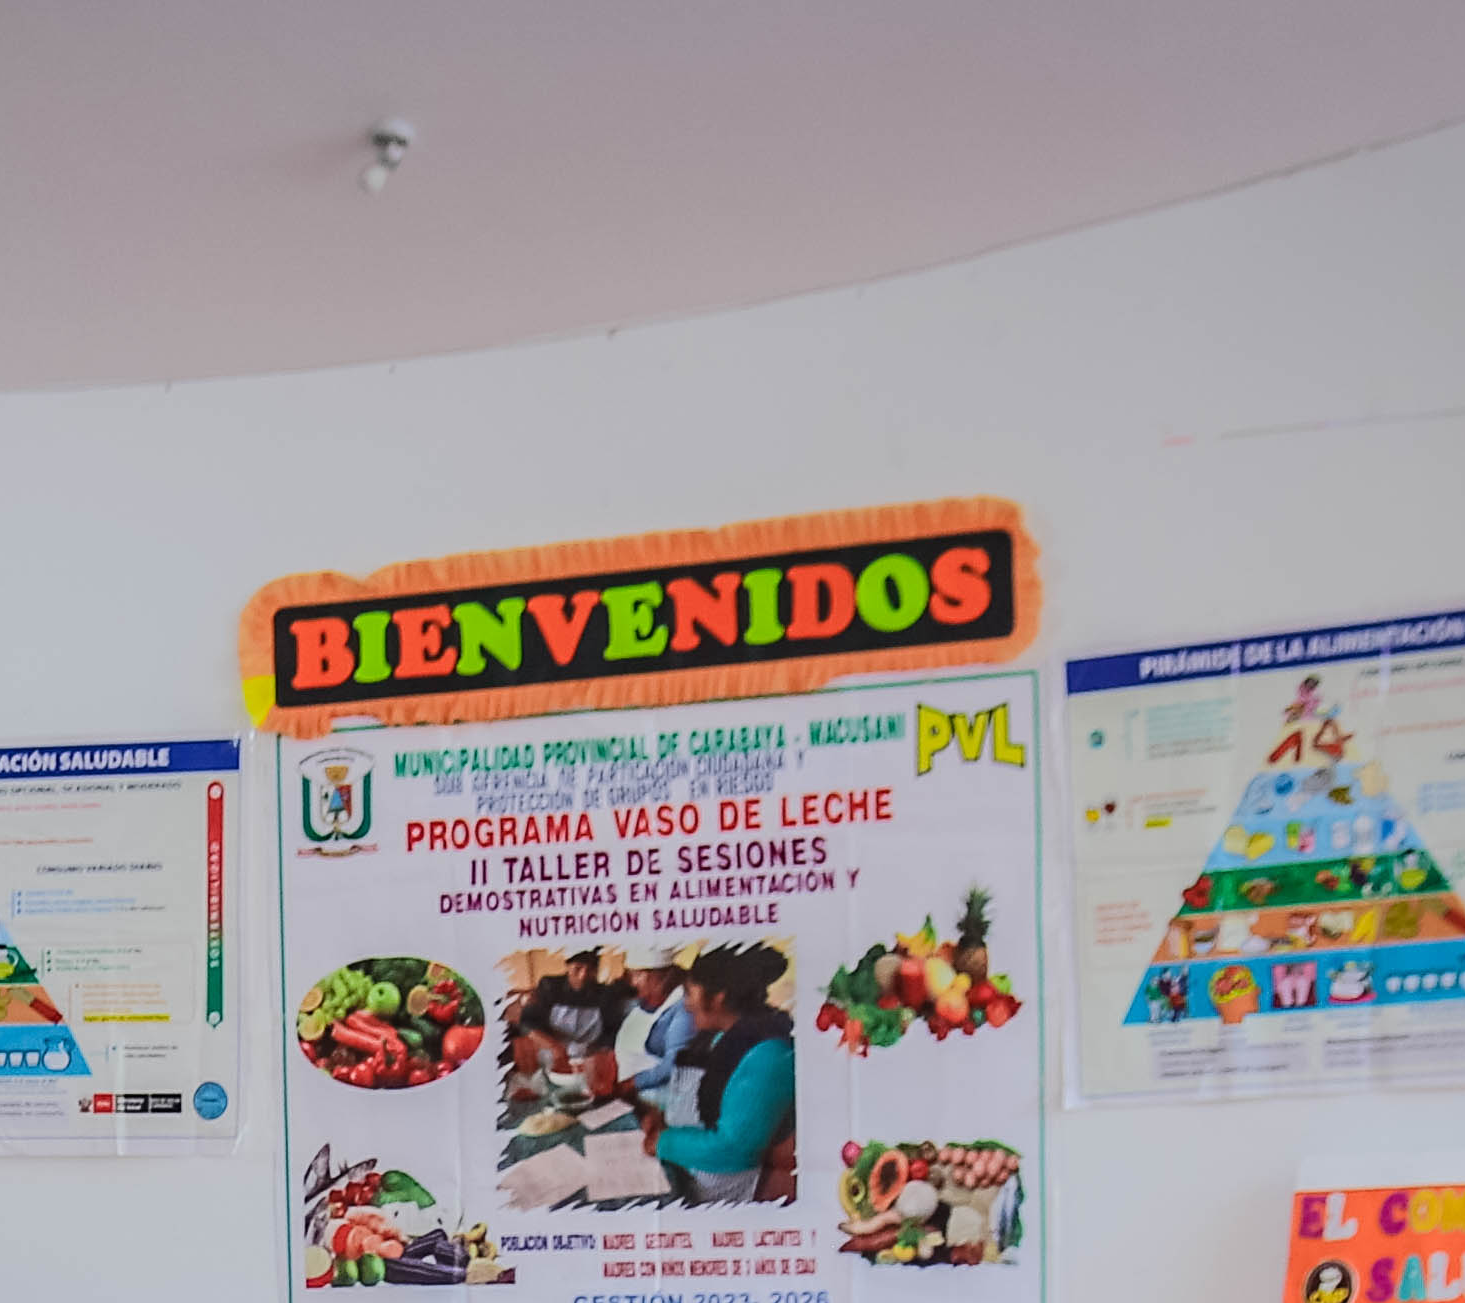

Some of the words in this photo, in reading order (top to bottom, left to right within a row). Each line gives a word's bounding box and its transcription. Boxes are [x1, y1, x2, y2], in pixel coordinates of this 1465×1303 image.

[290, 547, 992, 690] BIENVENIDOS
[59, 747, 171, 772] SALUDABLE
[395, 743, 535, 778] MUNICIPALIDAD
[544, 734, 650, 769] PROVINCIAL
[657, 730, 680, 760] DE
[917, 702, 1026, 776] PVL
[406, 812, 596, 853] PROGRAMA
[615, 803, 700, 840] VASO
[720, 799, 761, 832] DE
[781, 789, 894, 827] LECHE
[470, 859, 488, 886] II
[504, 851, 610, 884] TALLER
[628, 848, 661, 875] DE
[677, 836, 827, 872] SESIONES
[439, 884, 618, 914] DEMOSTRATIVAS
[630, 880, 657, 901] EN
[848, 869, 861, 889] Y
[519, 911, 640, 938] NUTRICIÓN
[653, 903, 780, 931] SALUDABLE
[1298, 1193, 1359, 1241] EL
